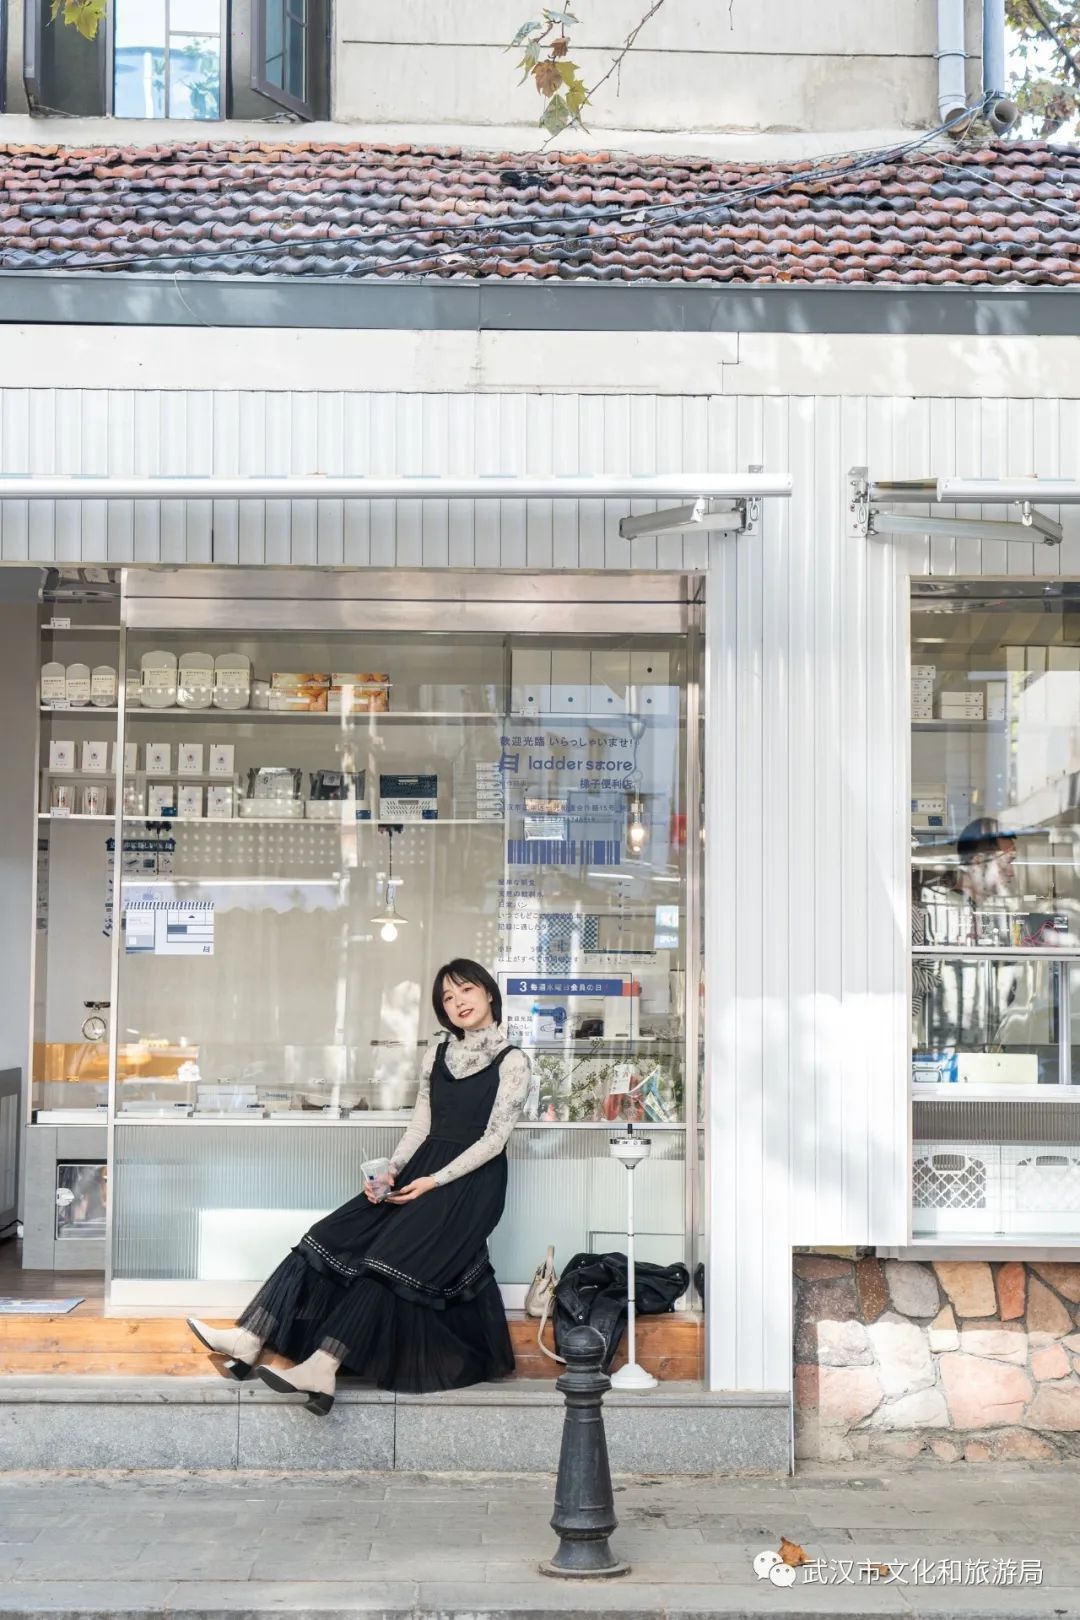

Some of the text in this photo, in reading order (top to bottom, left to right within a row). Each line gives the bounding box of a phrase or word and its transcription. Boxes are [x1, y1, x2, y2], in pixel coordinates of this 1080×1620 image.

[579, 778, 633, 790] 梯子便利店
[519, 981, 528, 992] 3
